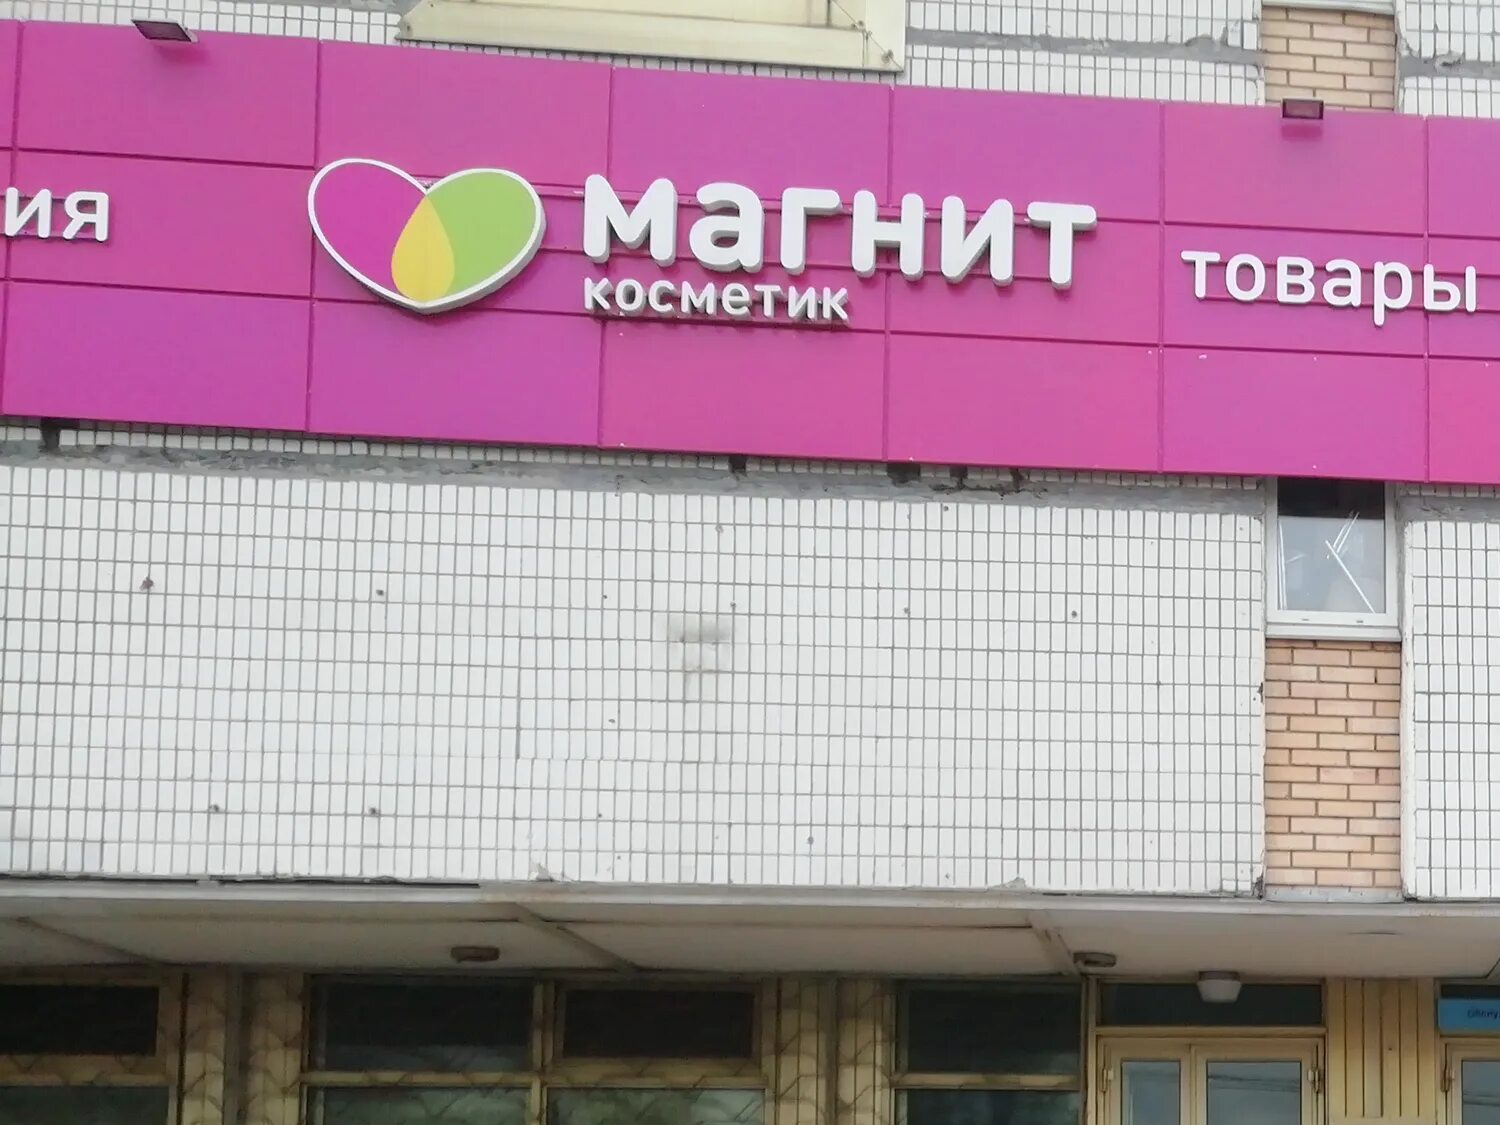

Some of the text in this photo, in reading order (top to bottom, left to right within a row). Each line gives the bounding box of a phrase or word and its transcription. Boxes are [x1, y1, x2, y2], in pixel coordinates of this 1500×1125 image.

[583, 174, 1098, 289] магнит
[584, 276, 850, 323] косметик
[1181, 250, 1478, 326] товары
